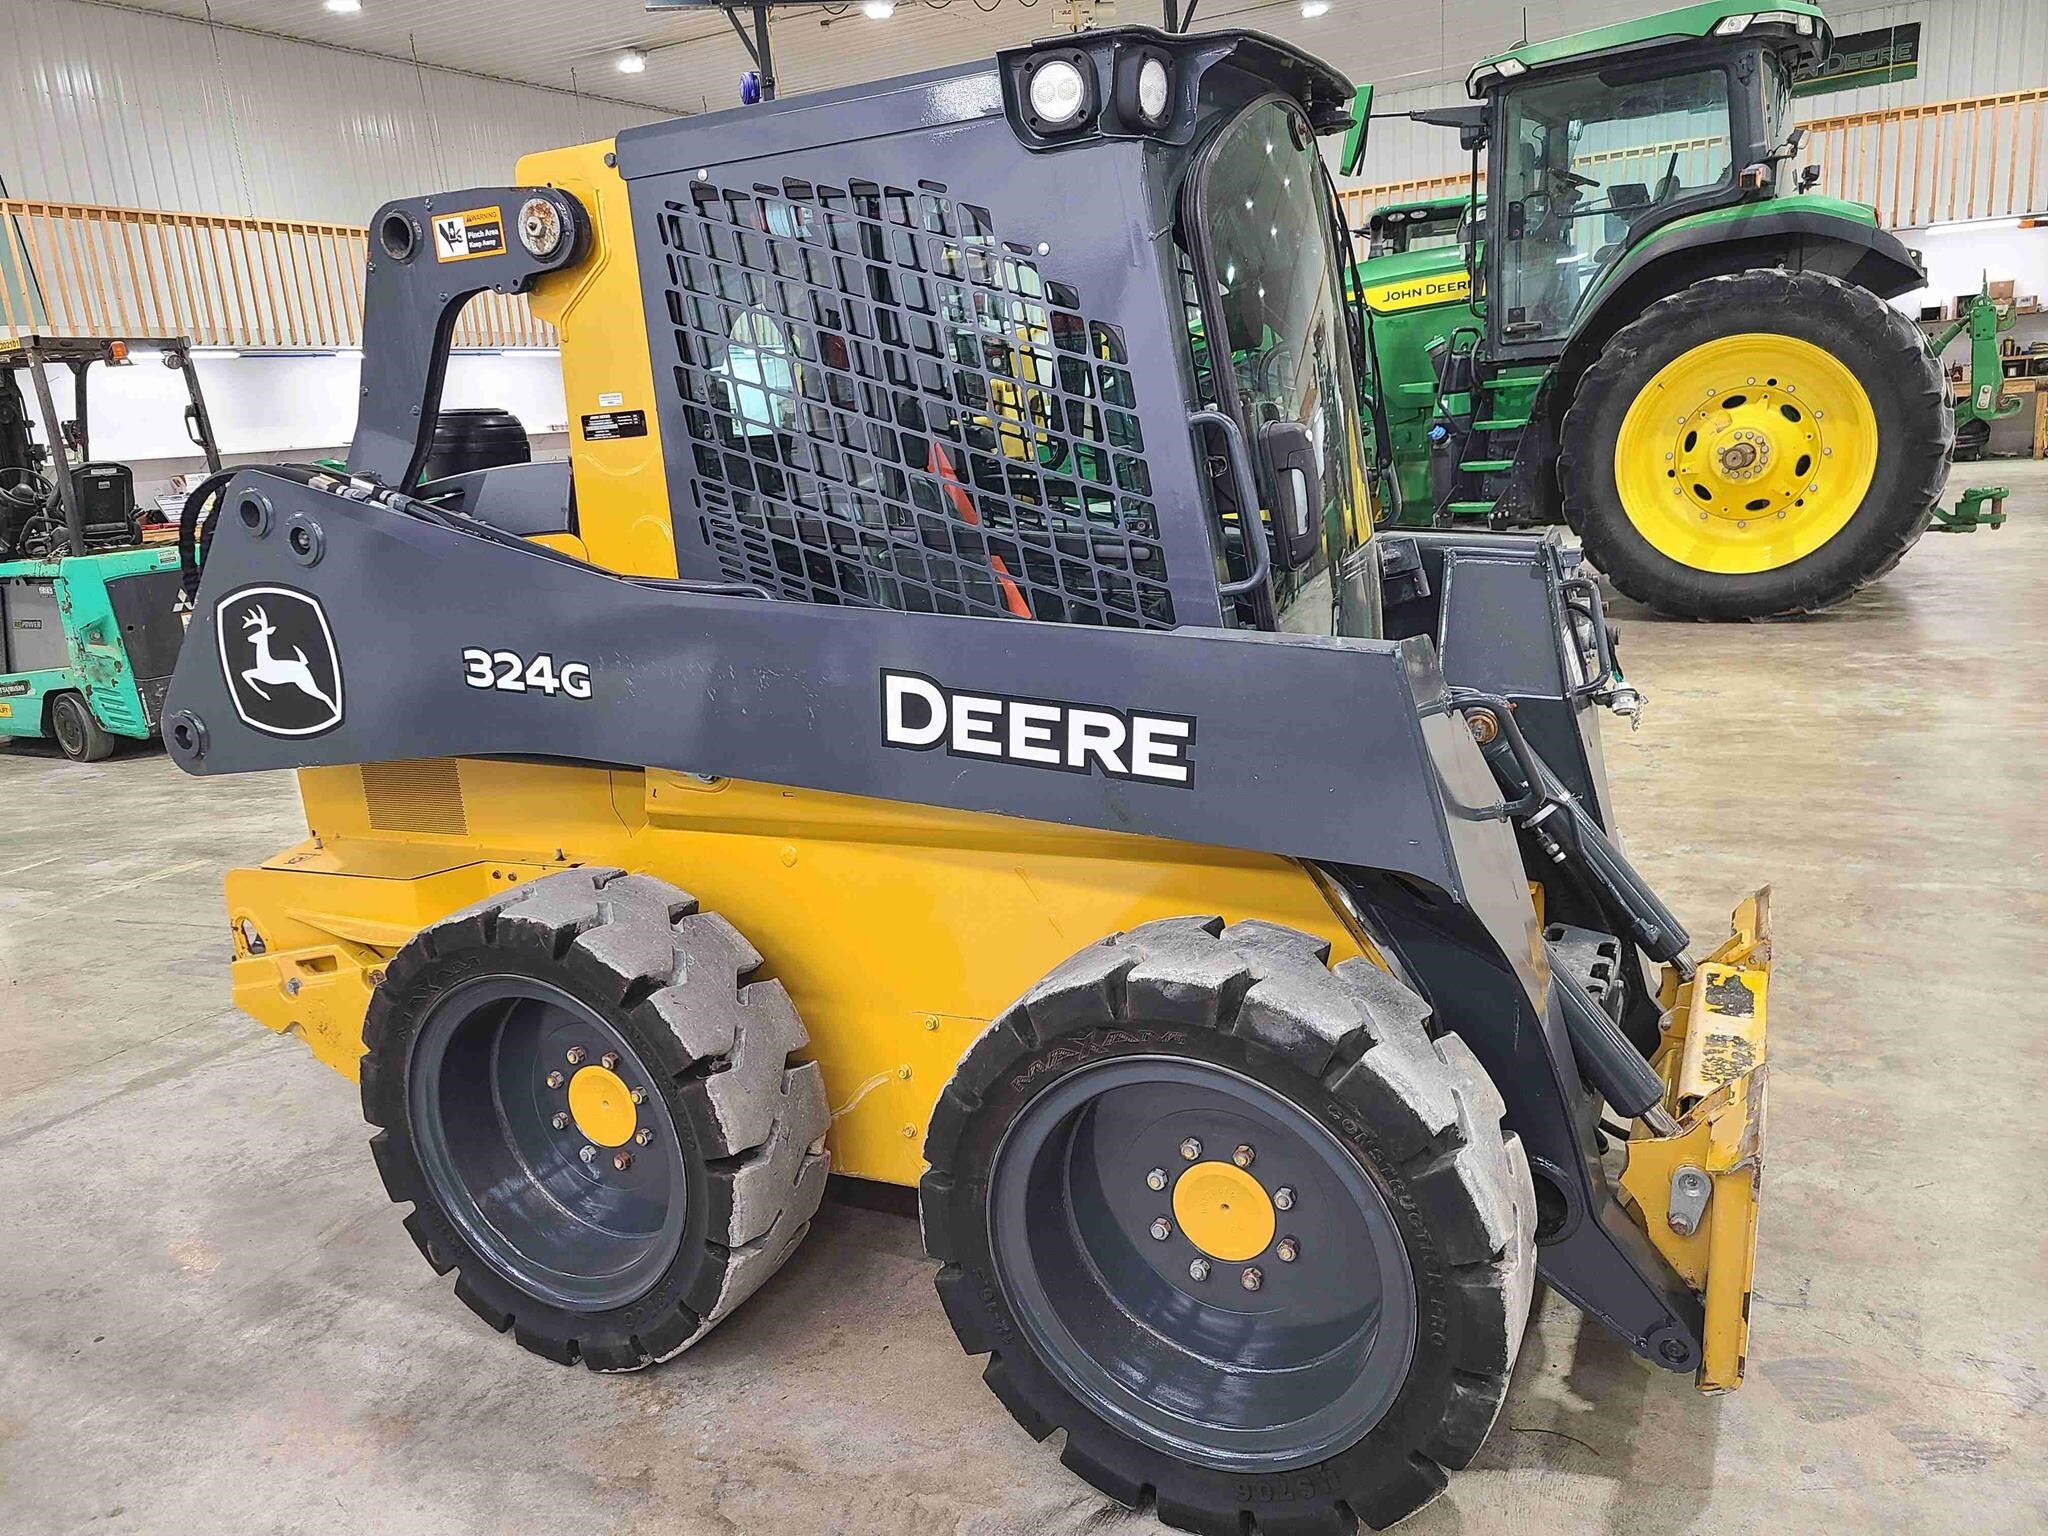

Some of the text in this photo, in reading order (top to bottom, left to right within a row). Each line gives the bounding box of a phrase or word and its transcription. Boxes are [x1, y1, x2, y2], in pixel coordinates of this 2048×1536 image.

[468, 228, 499, 239] Pinch Area
[1382, 288, 1422, 302] JOHN
[463, 648, 592, 699] 324G
[884, 672, 1191, 785] DEERE
